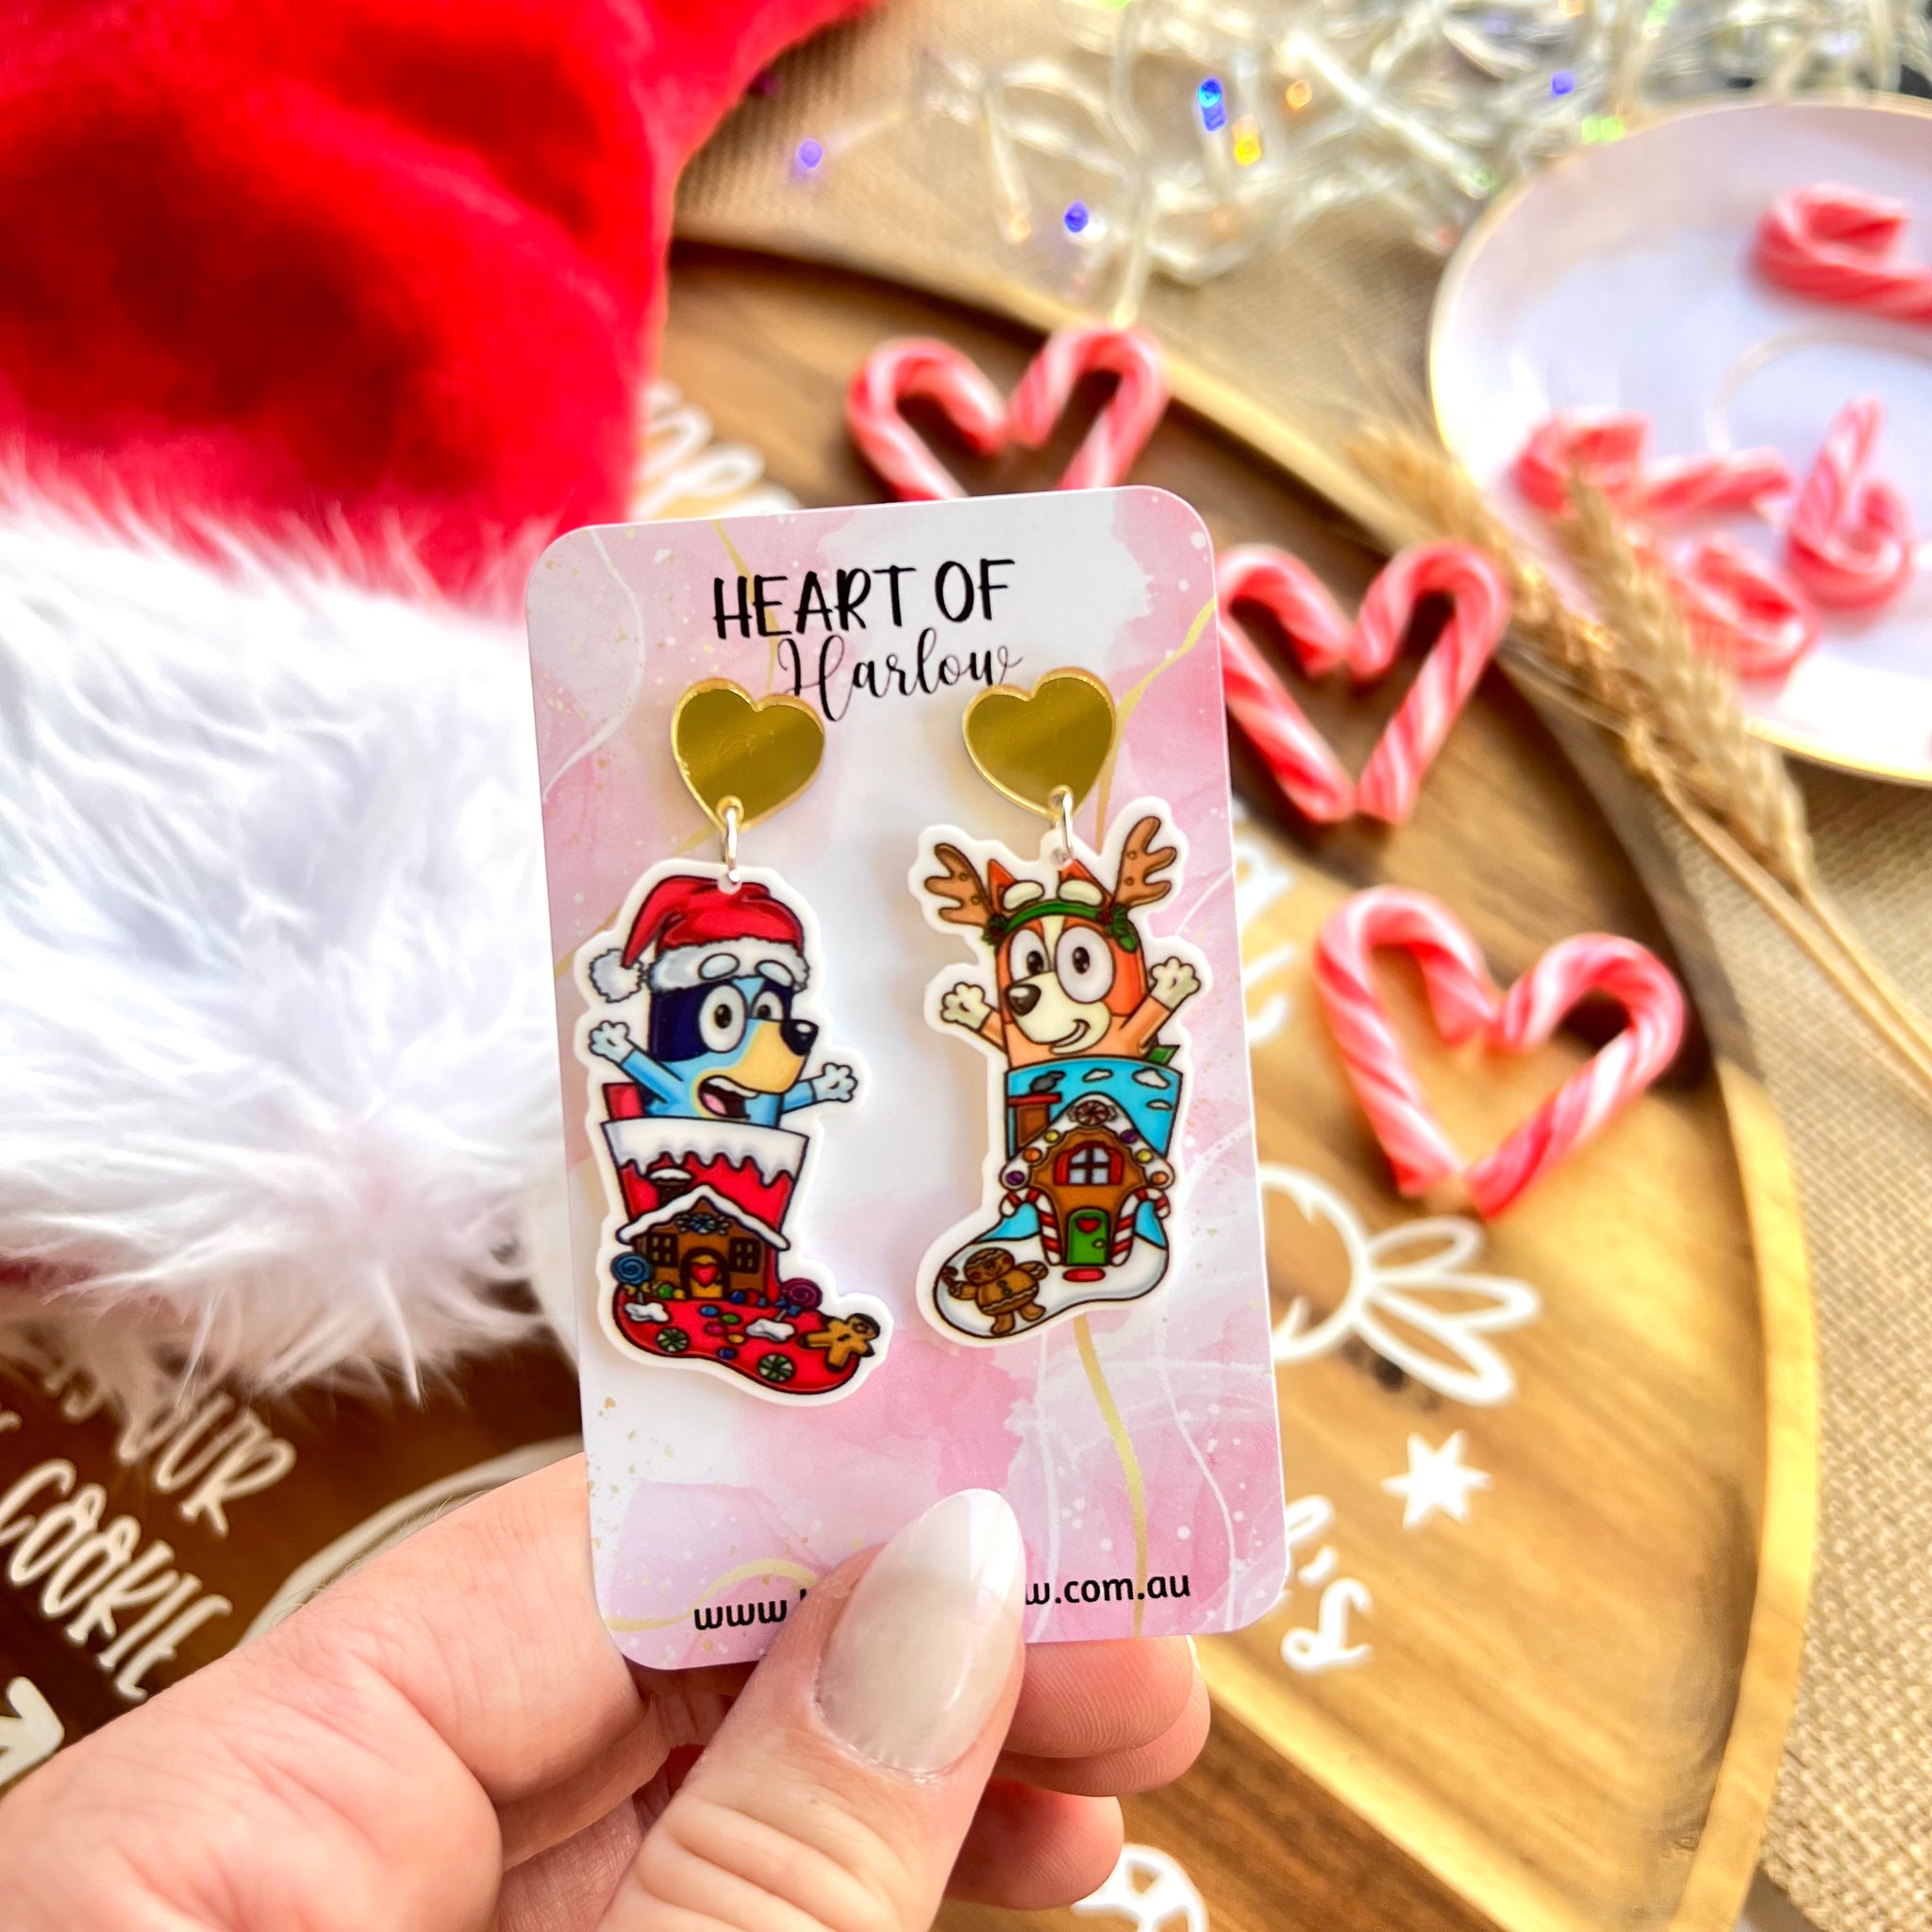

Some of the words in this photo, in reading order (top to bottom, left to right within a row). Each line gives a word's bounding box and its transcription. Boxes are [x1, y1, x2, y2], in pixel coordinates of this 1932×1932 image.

[713, 565, 917, 640] HEART
[935, 558, 1016, 623] OF
[776, 626, 1024, 722] Harlow
[0, 1457, 234, 1701] COOKIE
